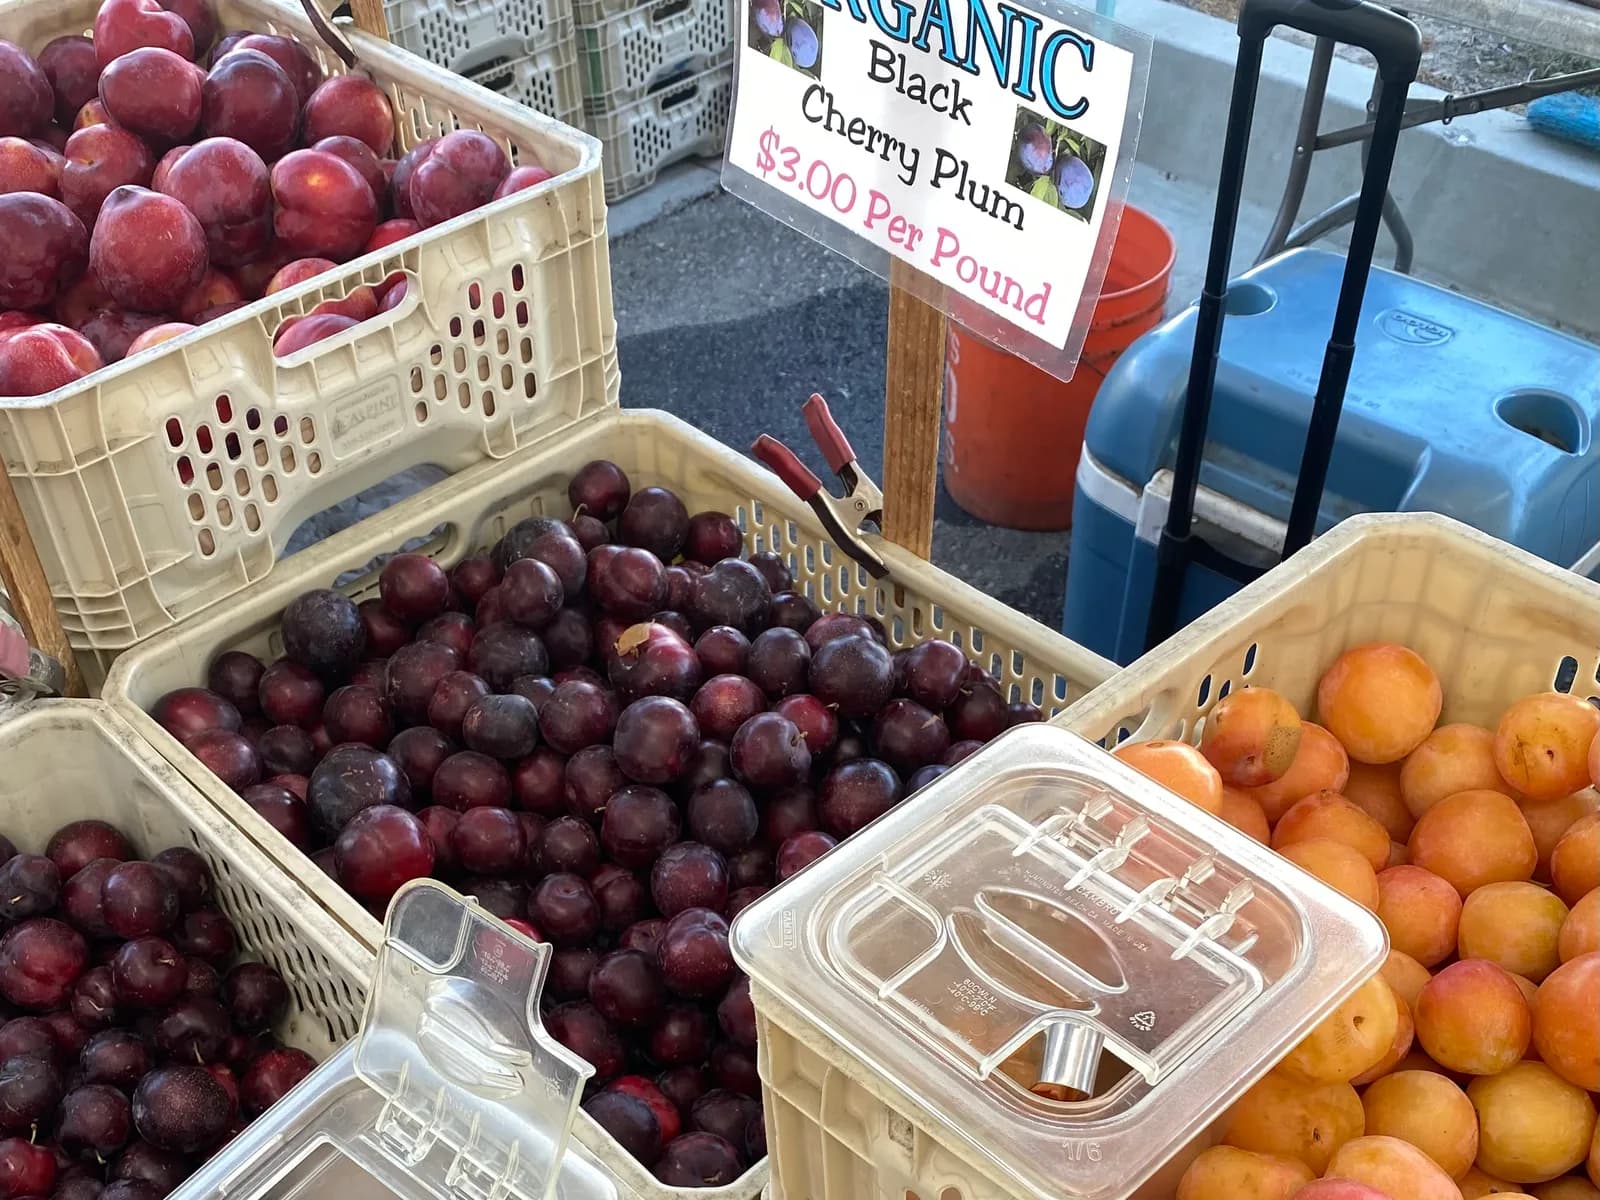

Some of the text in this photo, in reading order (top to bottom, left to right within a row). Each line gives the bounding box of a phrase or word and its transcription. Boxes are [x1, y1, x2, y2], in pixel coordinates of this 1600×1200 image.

[867, 39, 973, 126] Black
[801, 84, 1025, 231] Cherry Plum
[756, 125, 1052, 325] $3.00 Per Pound
[1061, 1141, 1103, 1162] 1/6
